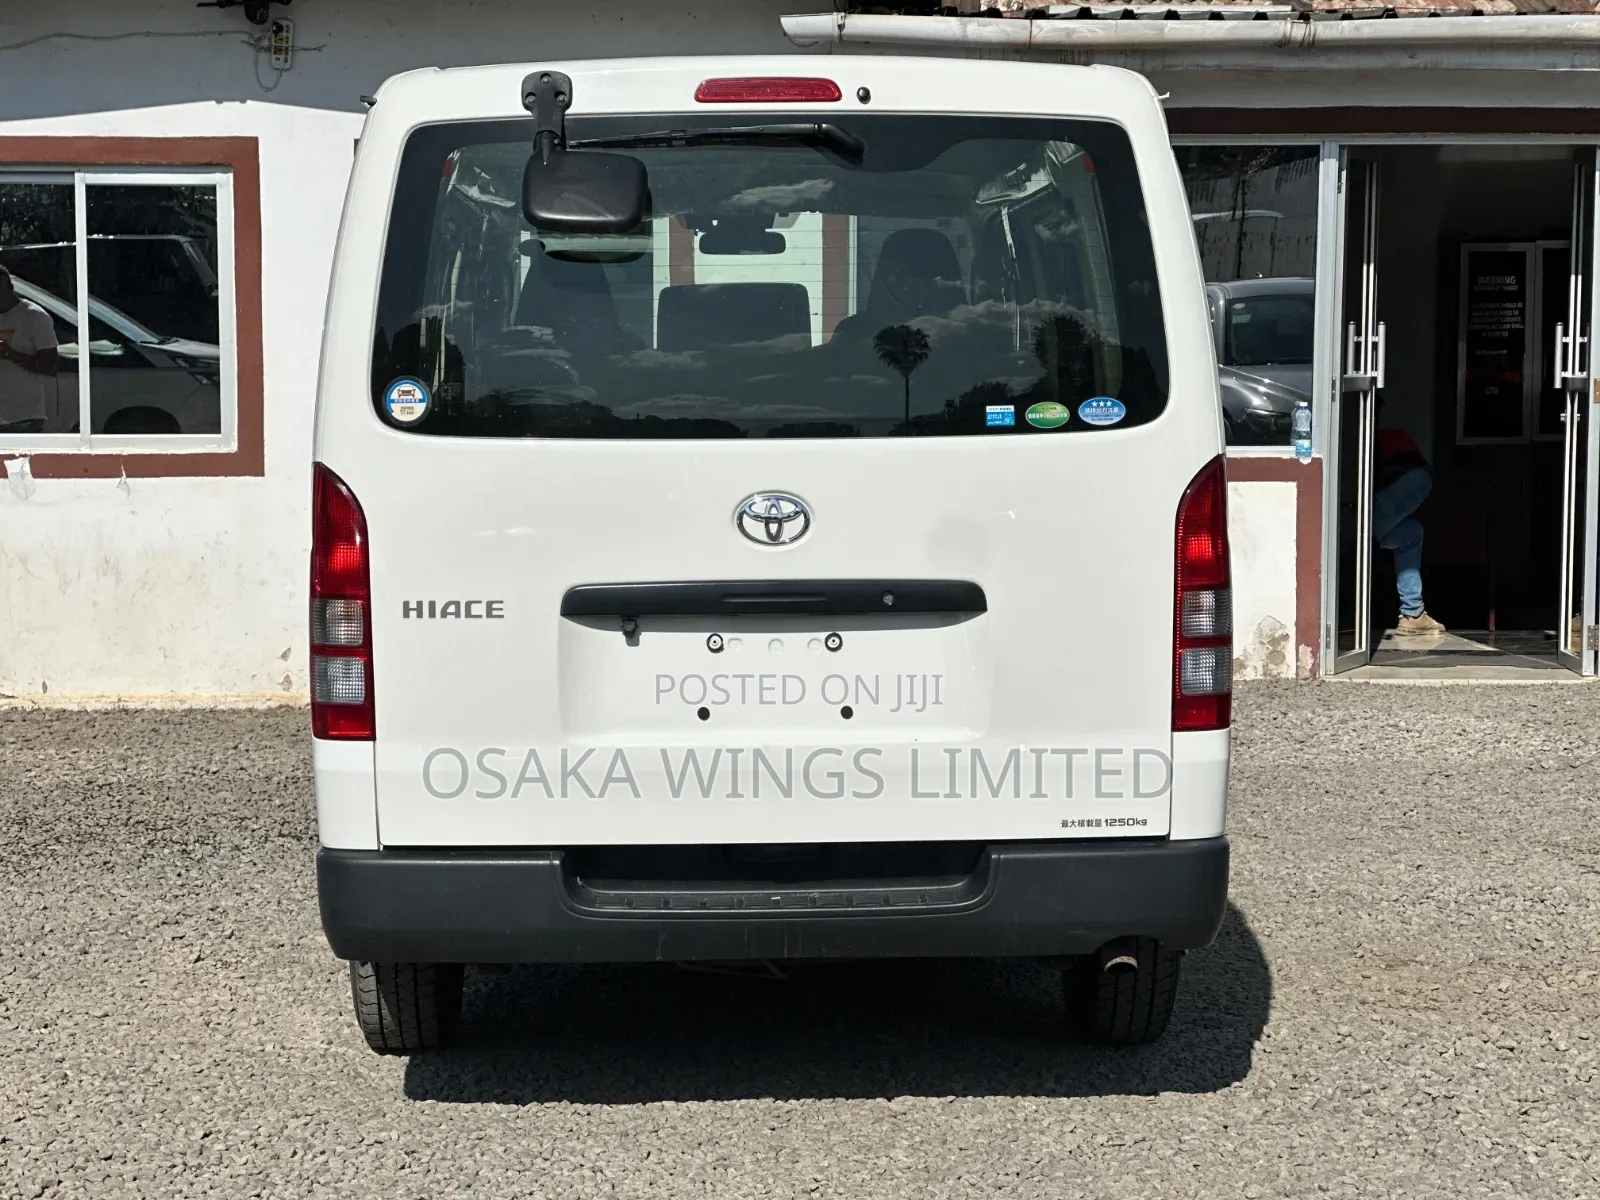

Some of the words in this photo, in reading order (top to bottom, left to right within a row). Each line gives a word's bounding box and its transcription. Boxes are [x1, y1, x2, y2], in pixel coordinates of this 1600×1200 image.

[1478, 275, 1516, 284] WARNING
[402, 600, 505, 619] HIACE
[1104, 817, 1148, 827] 1250kg
